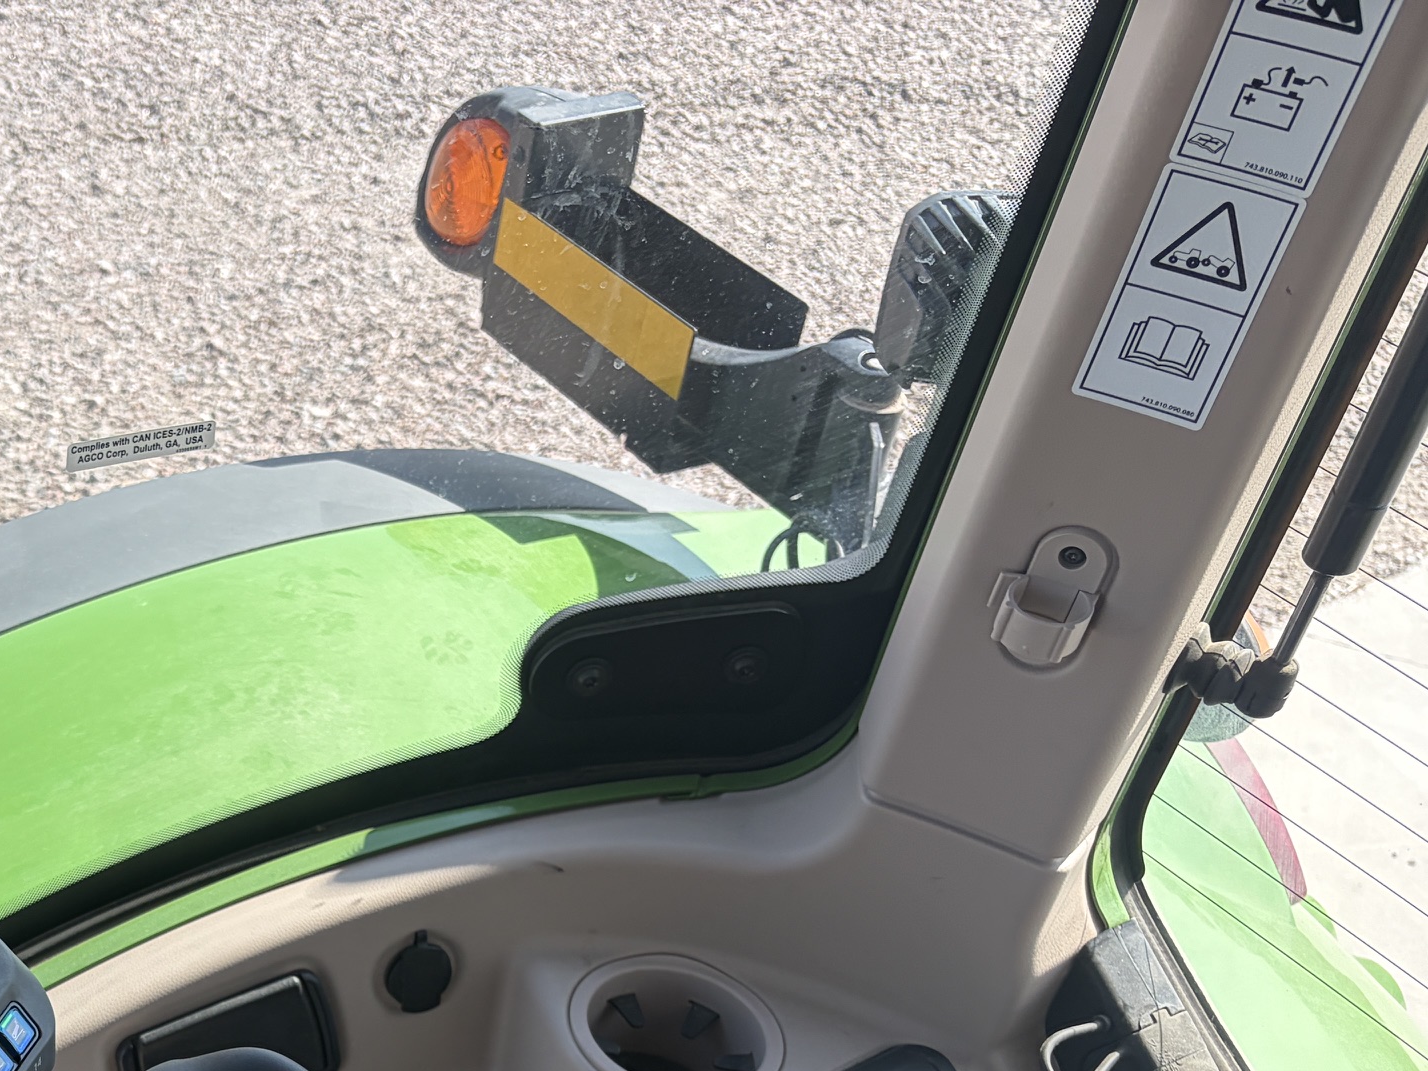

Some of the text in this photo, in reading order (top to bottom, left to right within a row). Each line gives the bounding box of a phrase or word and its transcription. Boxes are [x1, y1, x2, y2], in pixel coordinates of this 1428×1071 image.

[1244, 162, 1304, 184] 743.810.090.110
[1141, 396, 1195, 418] 743.810.090.080
[71, 423, 213, 455] Complies with CAN ICES-2/NMB-2
[77, 452, 104, 464] AGCO
[133, 442, 163, 454] Duluth,
[165, 439, 181, 448] GA,
[185, 435, 204, 446] USA
